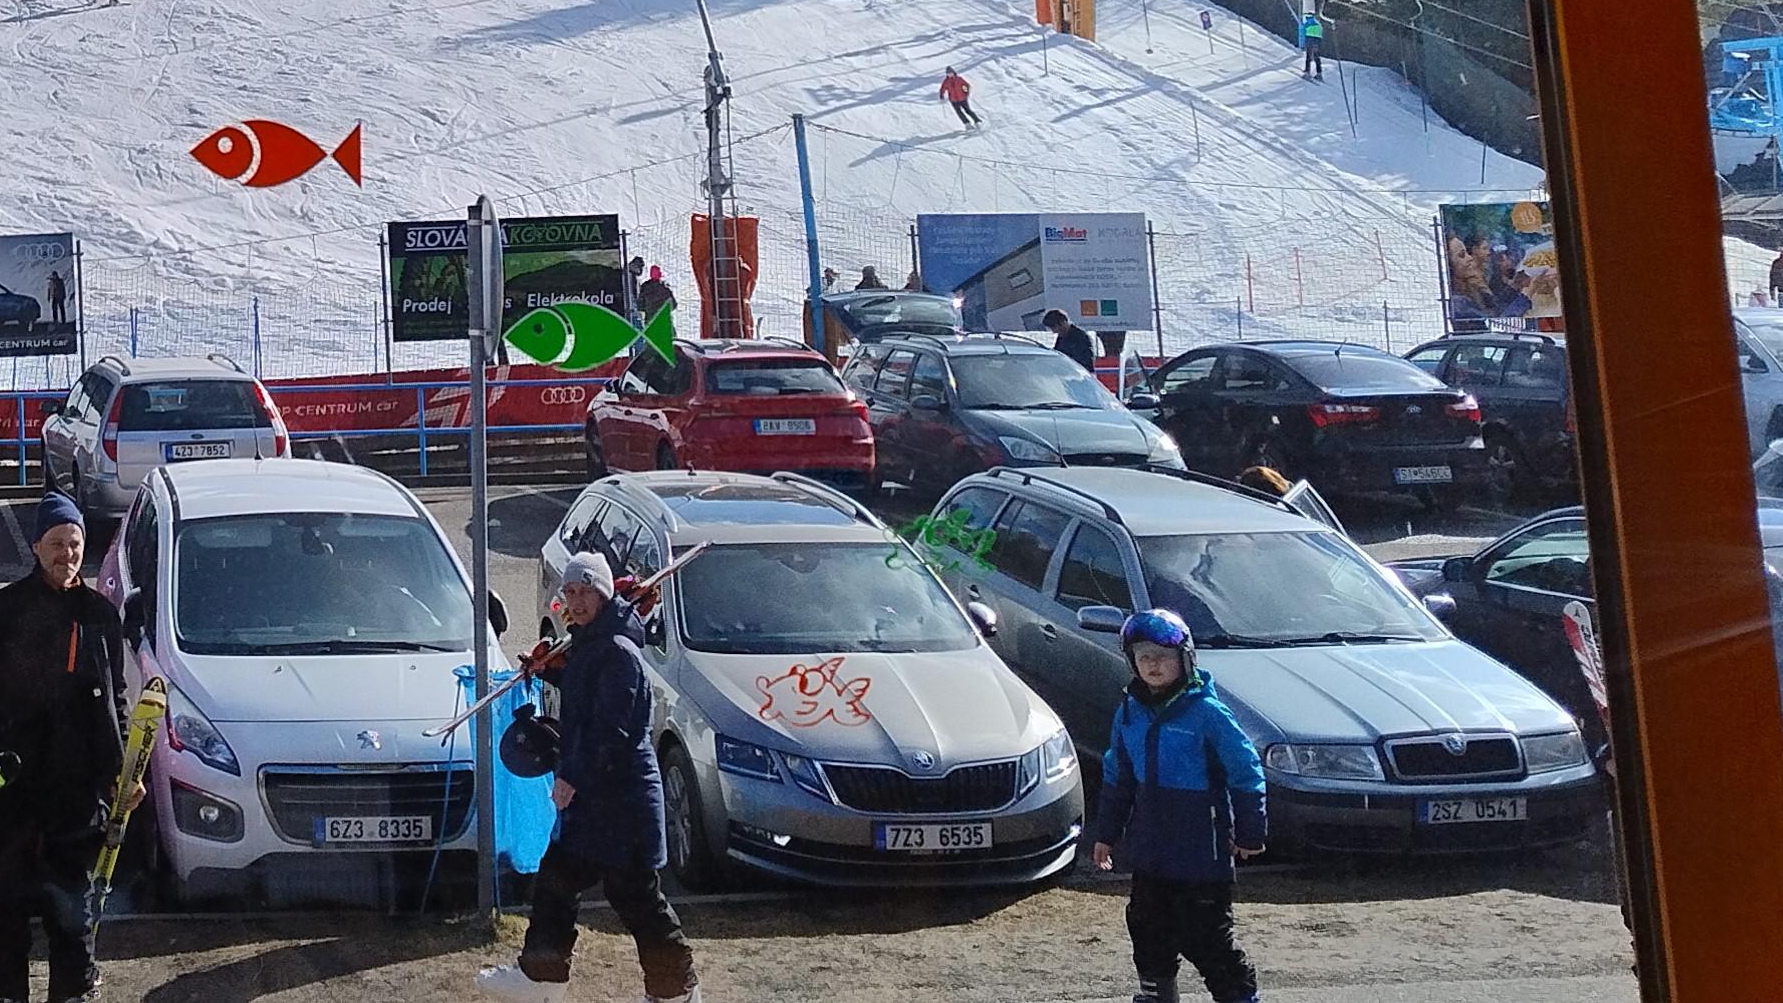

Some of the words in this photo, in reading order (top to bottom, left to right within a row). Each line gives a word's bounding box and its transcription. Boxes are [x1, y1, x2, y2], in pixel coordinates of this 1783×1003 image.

[1045, 226, 1088, 240] BigMat
[403, 298, 452, 314] Prodej
[295, 401, 372, 416] CENTRUM
[377, 401, 398, 412] car
[132, 723, 156, 784] FISCHER
[1432, 802, 1463, 821] 2SZ
[1475, 800, 1518, 819] 0541
[330, 820, 364, 838] 6Z3
[378, 819, 423, 838] 8335
[890, 827, 925, 848] 7Z3
[939, 826, 984, 847] 6535
